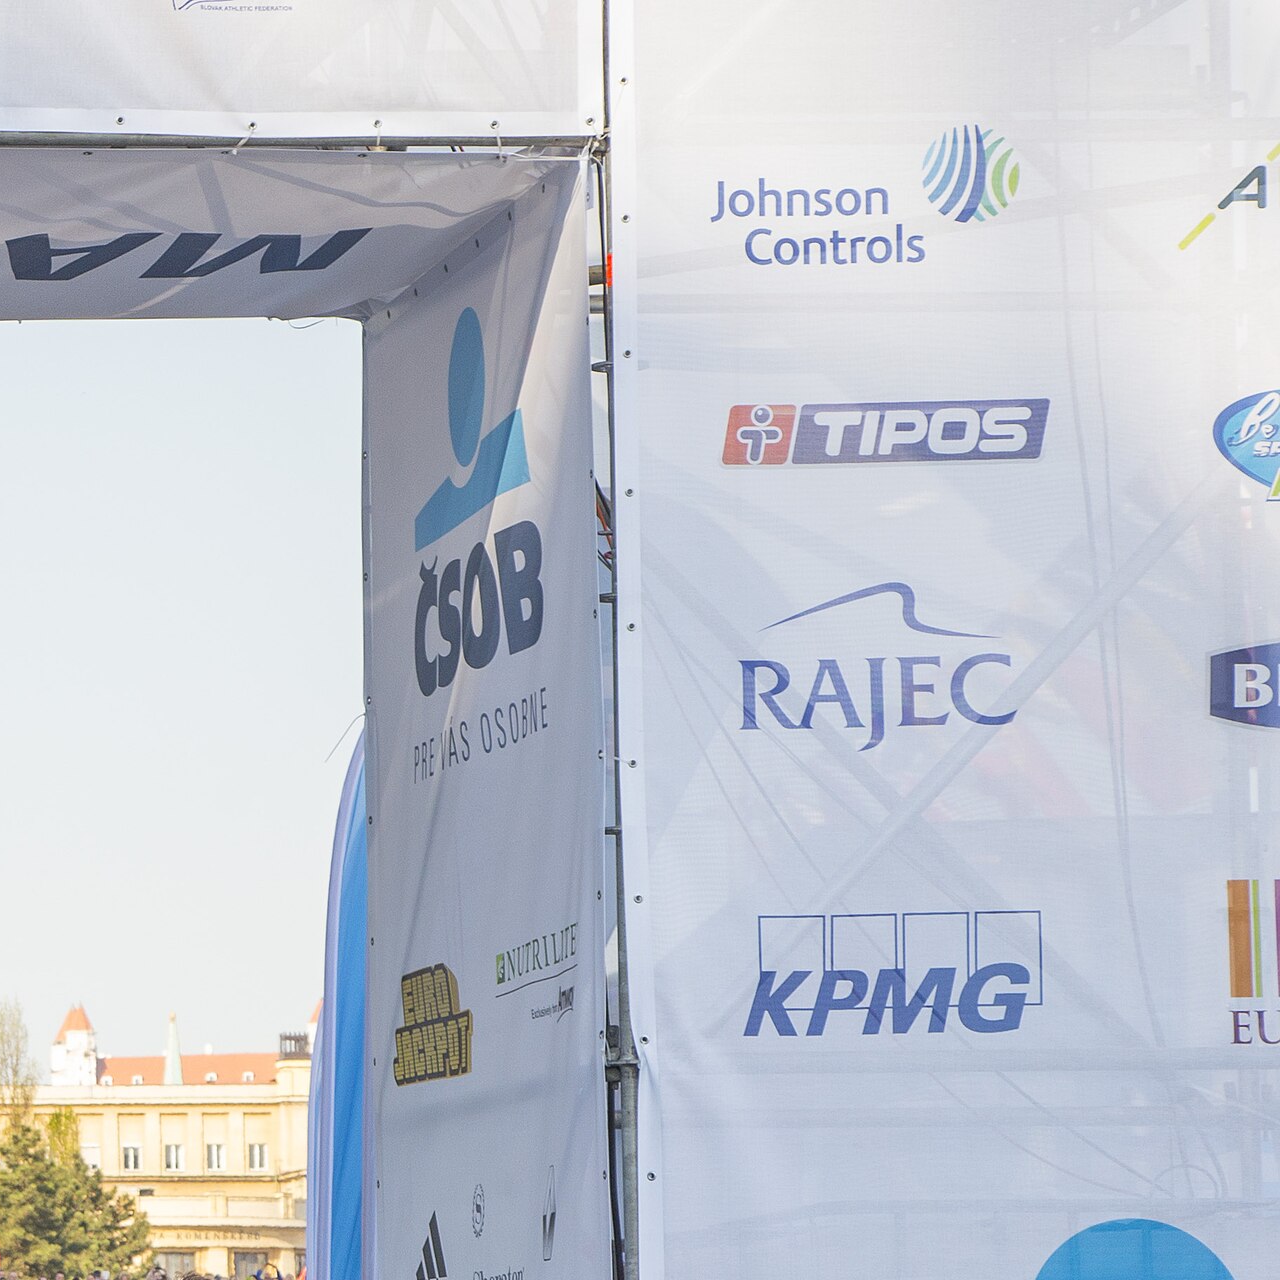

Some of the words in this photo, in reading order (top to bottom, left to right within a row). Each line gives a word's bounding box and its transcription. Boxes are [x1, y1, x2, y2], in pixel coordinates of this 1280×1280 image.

[710, 179, 890, 223] Johnson
[745, 225, 925, 266] Controls
[814, 407, 1029, 456] TIPOS
[414, 521, 544, 697] ČSOB
[738, 652, 1017, 751] RAJEC
[413, 741, 436, 785] PRE
[440, 715, 472, 774] VÁS
[481, 696, 549, 758] OSOBNE
[507, 923, 578, 981] NUTRILITE
[744, 963, 1031, 1036] KPMG
